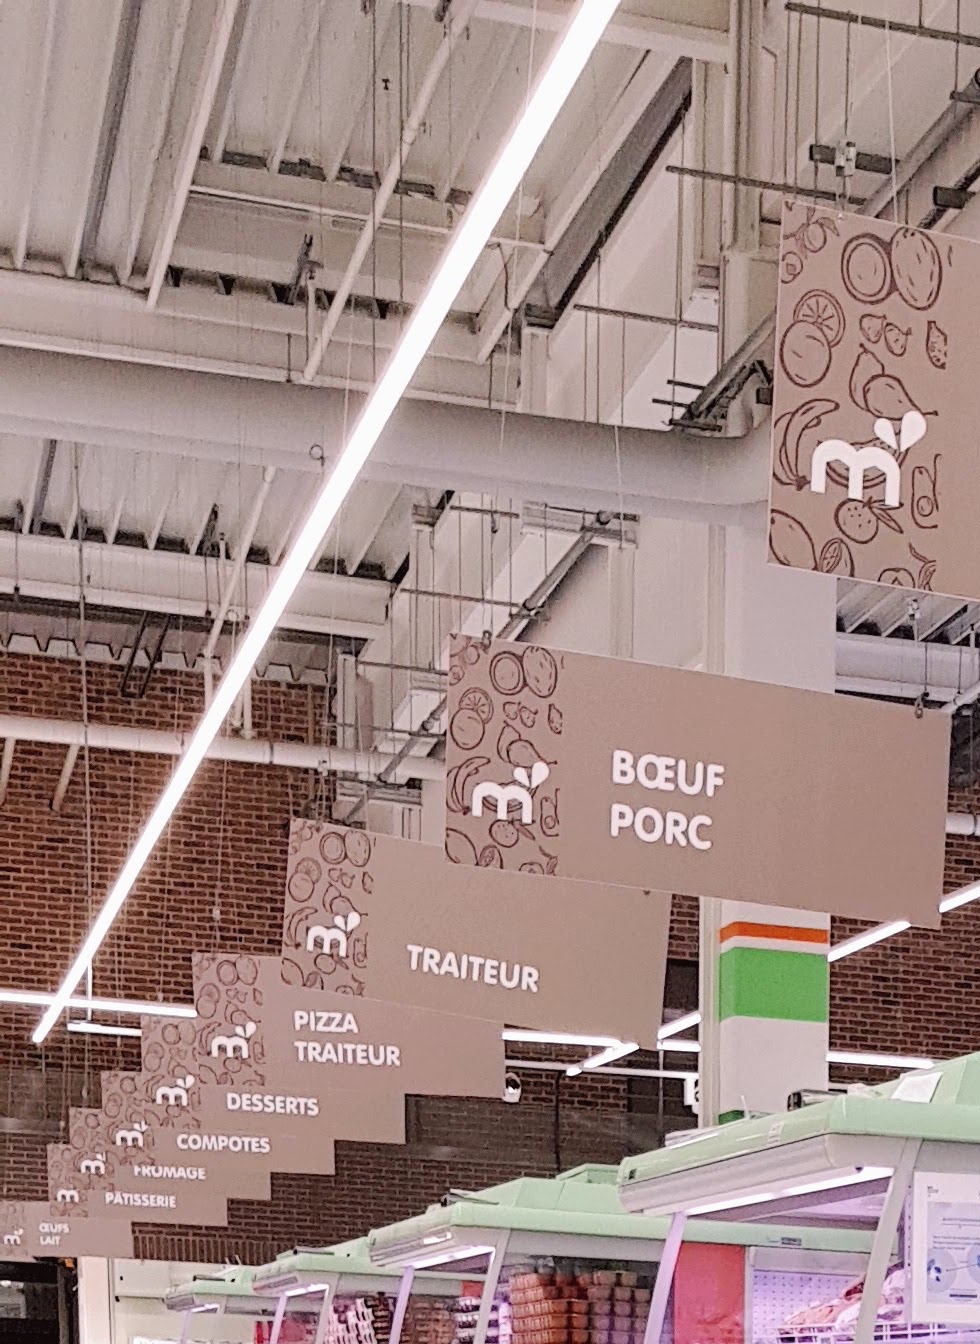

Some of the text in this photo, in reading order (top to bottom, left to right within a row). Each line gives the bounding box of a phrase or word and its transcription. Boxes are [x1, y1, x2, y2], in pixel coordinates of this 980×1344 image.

[611, 749, 725, 797] BŒUF
[610, 804, 713, 850] PORC
[406, 944, 539, 992] TRAITEUR
[293, 1010, 359, 1034] PIZZA
[294, 1040, 401, 1067] TRAITEUR
[226, 1092, 320, 1117] DESSERTS
[176, 1134, 271, 1154] COMPOTES
[133, 1165, 207, 1180] FROMAGE
[40, 1236, 60, 1246] LAIT
